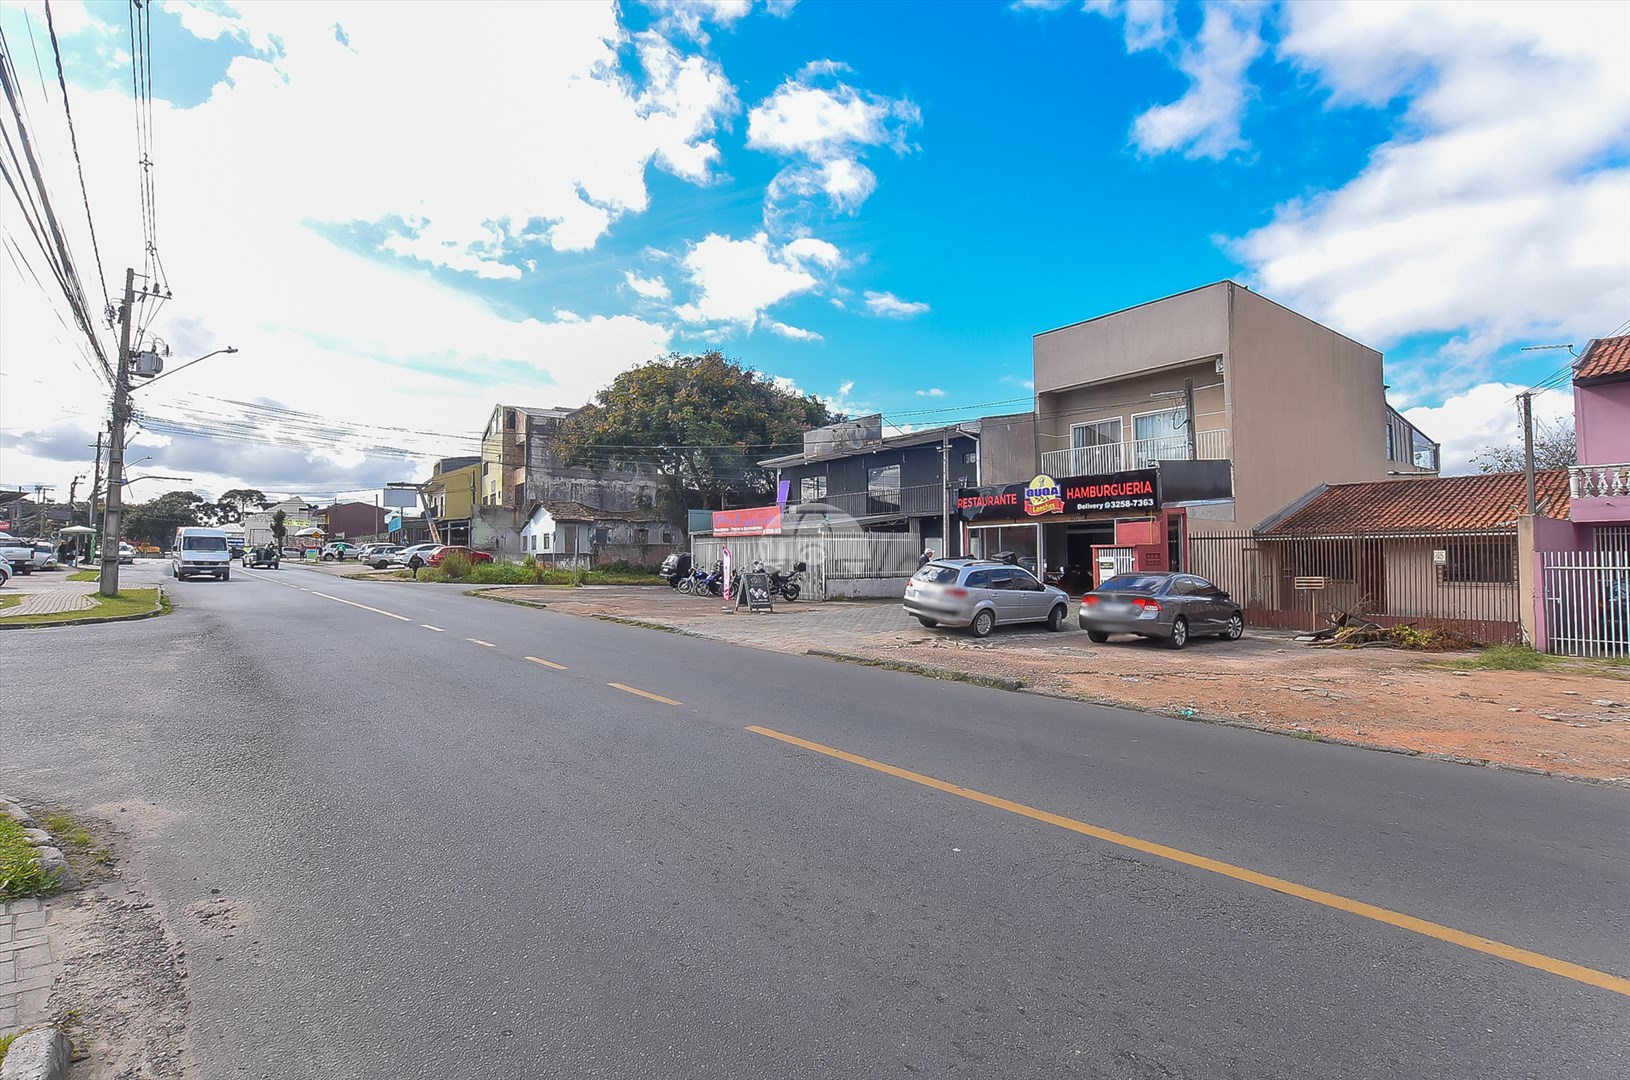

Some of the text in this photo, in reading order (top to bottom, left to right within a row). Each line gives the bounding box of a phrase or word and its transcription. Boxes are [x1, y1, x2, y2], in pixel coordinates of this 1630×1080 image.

[1066, 481, 1153, 499] HAMBURGUERIA
[958, 494, 1017, 509] RESTAURANTE
[1077, 499, 1154, 511] Delivery 3258-7363
